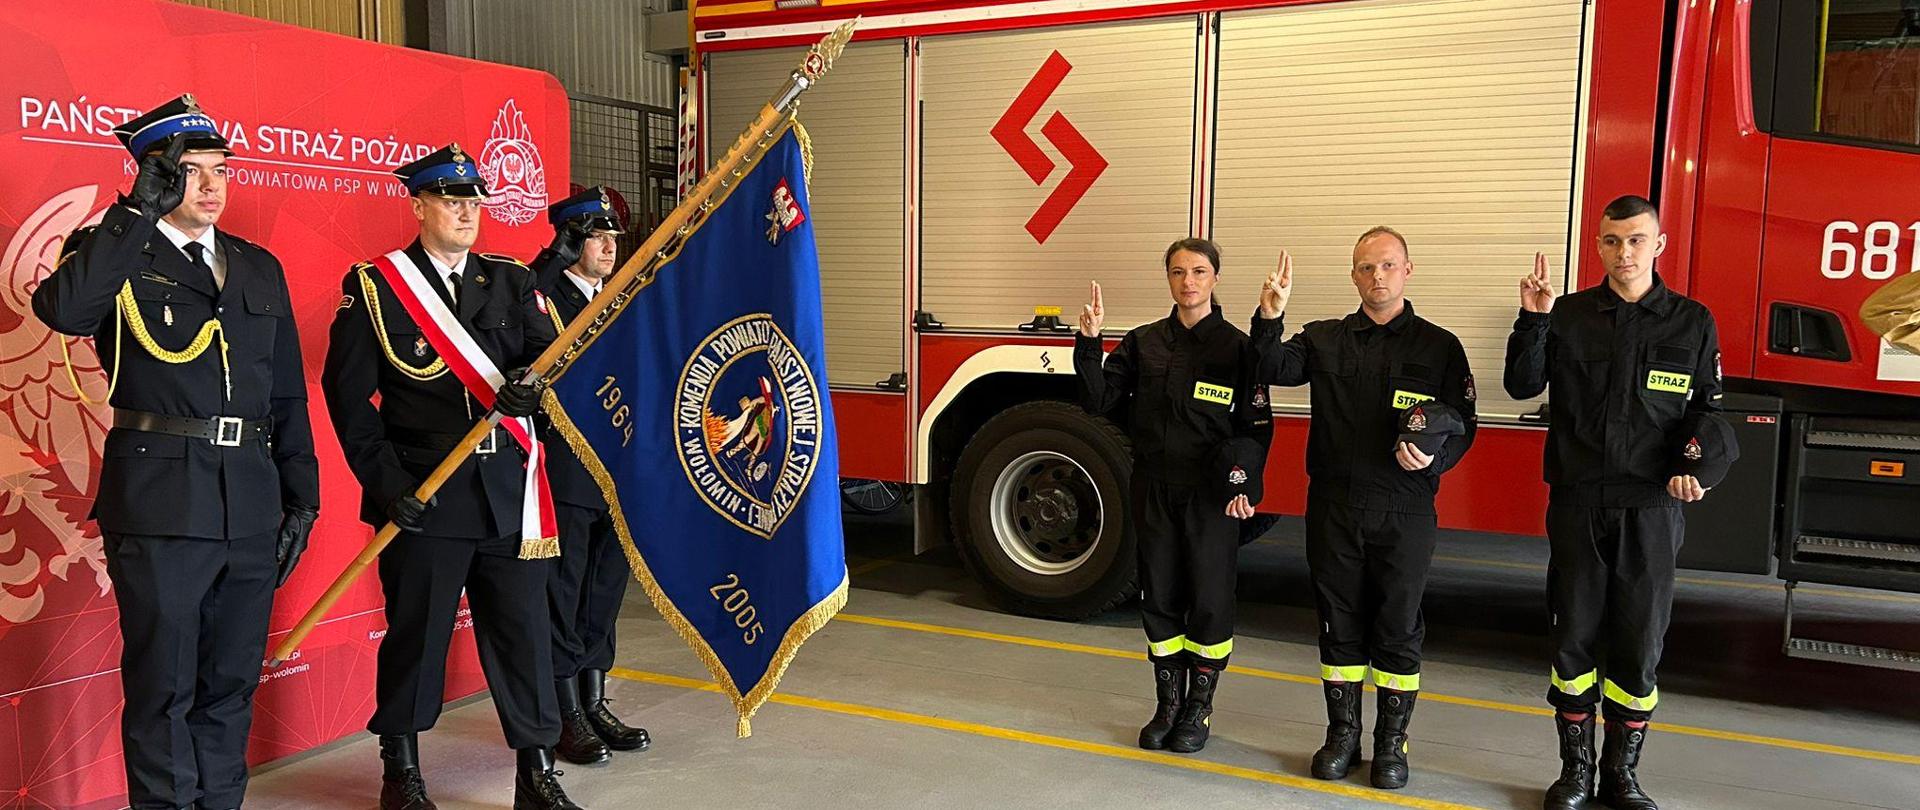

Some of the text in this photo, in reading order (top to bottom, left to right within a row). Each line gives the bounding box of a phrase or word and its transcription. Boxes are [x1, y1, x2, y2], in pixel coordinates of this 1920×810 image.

[257, 125, 344, 161] STRAŻ
[226, 167, 328, 192] POWIATOWA
[334, 177, 362, 194] PSP
[366, 182, 379, 195] W
[595, 375, 634, 448] 1964
[680, 355, 720, 428] KOMENDA
[709, 320, 770, 362] POWIATO
[767, 332, 817, 447] PAŃSTWOWEJ
[683, 437, 742, 514] WOŁOMIN
[709, 573, 764, 645] 2005
[259, 663, 310, 683] sp-wolomin
